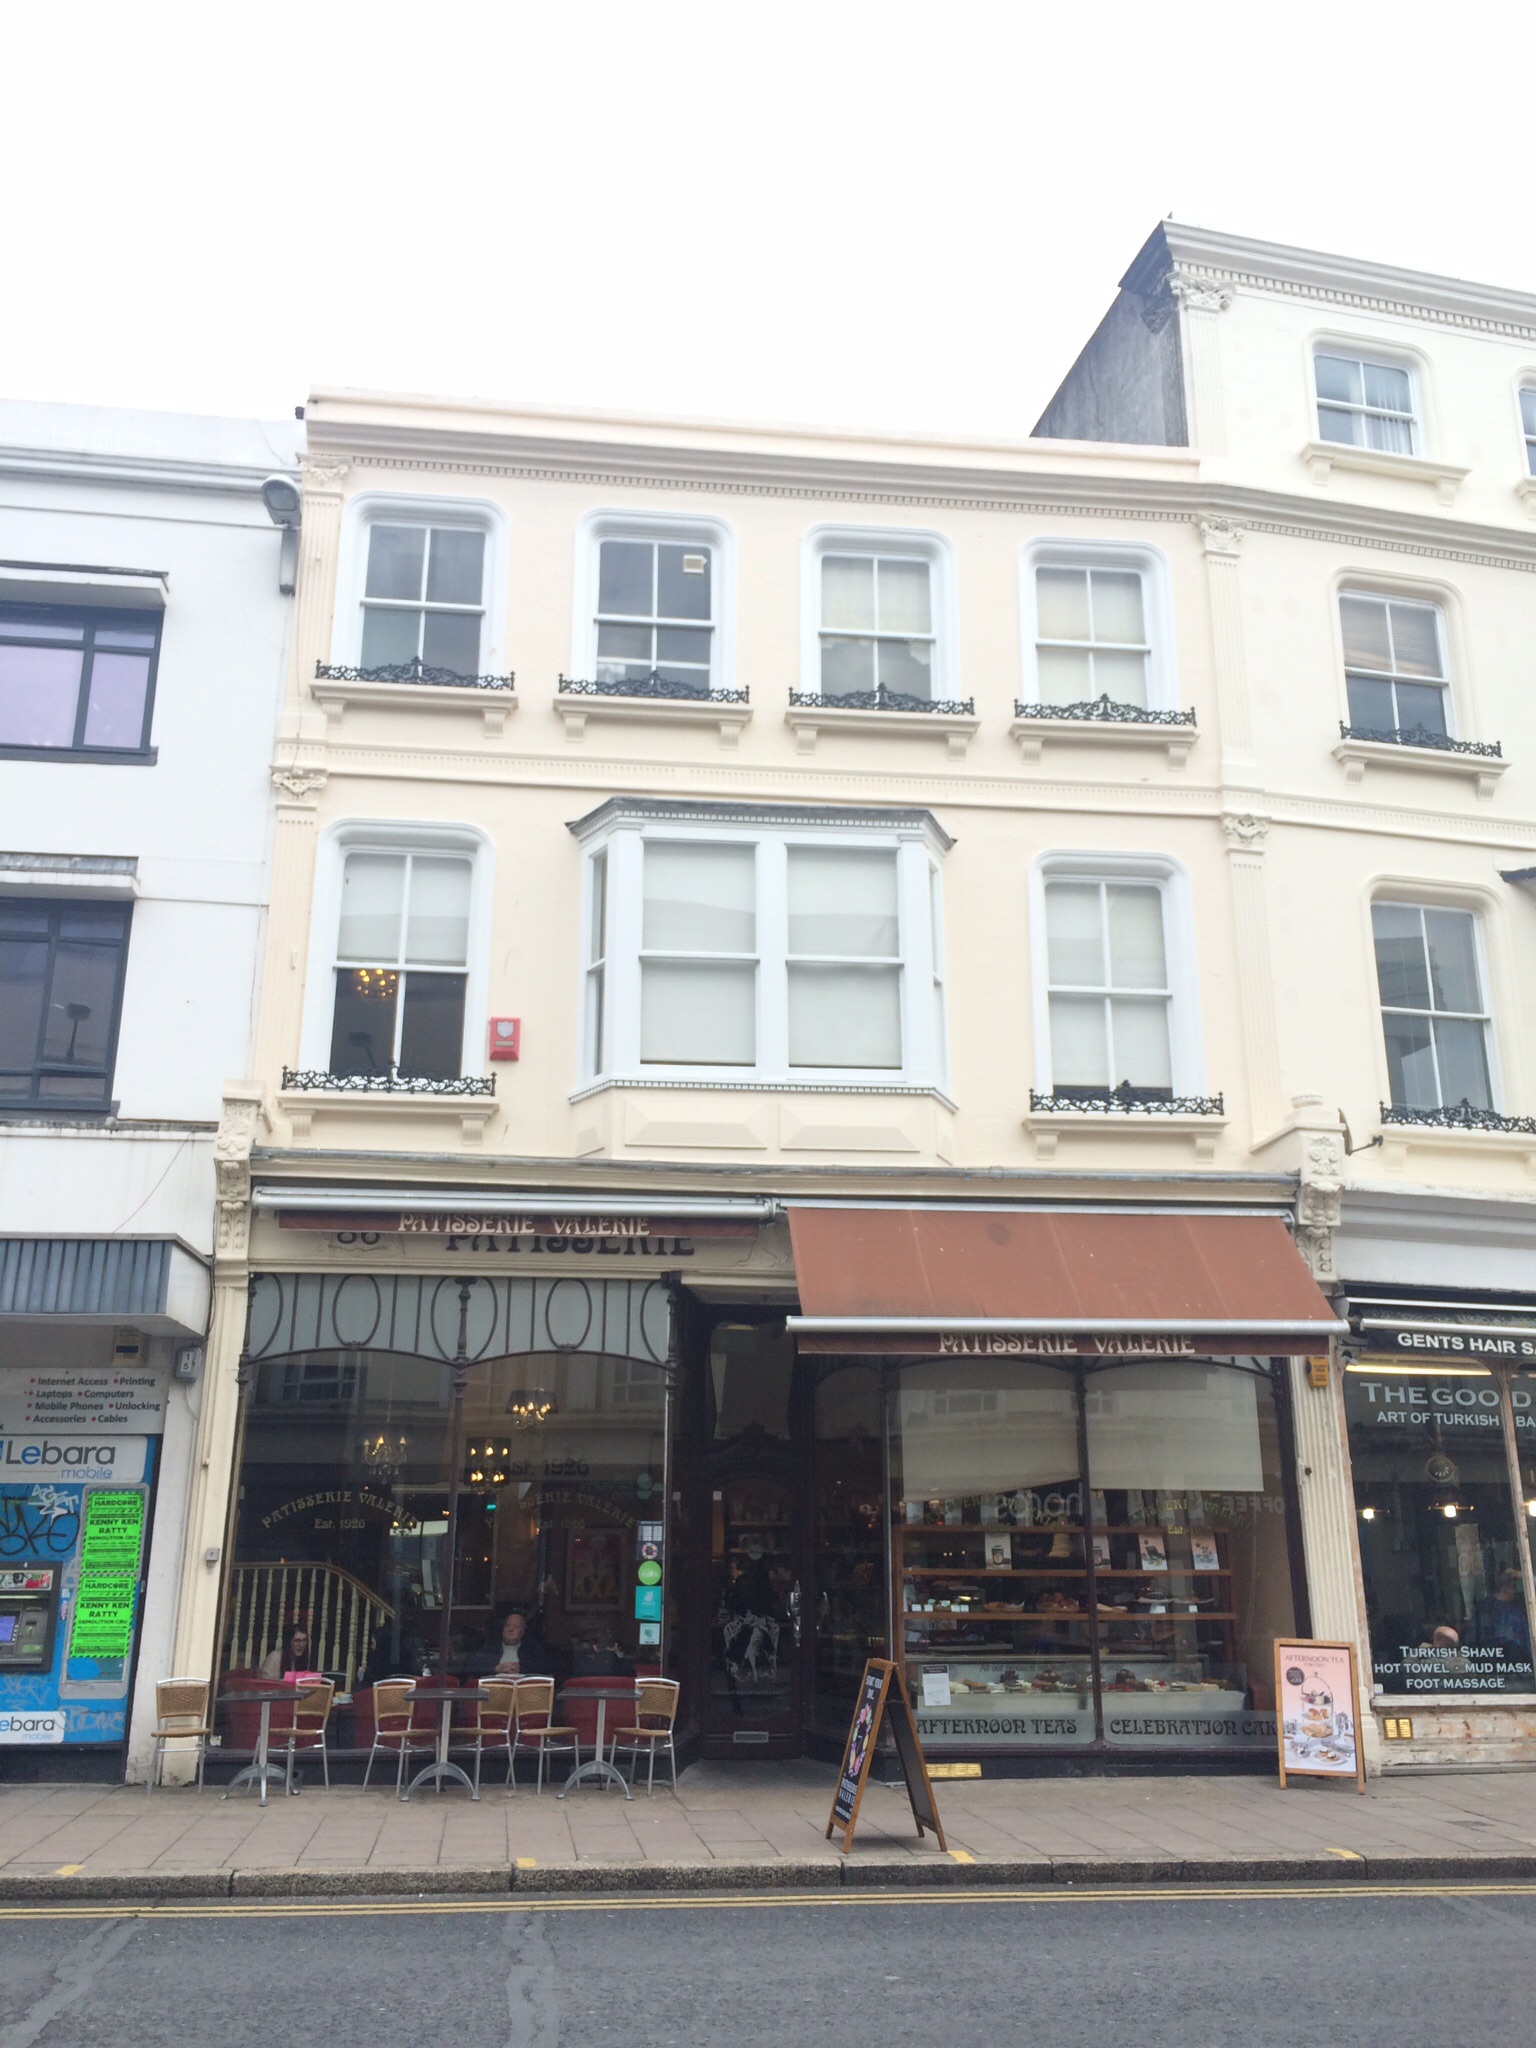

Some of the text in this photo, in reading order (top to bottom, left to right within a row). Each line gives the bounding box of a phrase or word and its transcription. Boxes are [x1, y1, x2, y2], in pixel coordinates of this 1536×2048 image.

[398, 1213, 650, 1236] PATISSERIE VALERIE
[938, 1332, 1195, 1354] PATISSERIE VALERIE
[1397, 1333, 1465, 1350] GENTS
[1469, 1337, 1518, 1354] HAIR
[37, 1376, 156, 1387] Internet Access Printing
[36, 1389, 135, 1399] Laptops Computers
[1359, 1382, 1429, 1404] THE
[35, 1402, 161, 1412] Mobile Phones Unlocking
[33, 1415, 128, 1423] Accessories Cables
[1377, 1411, 1407, 1423] ART
[1410, 1411, 1431, 1424] OF
[1433, 1413, 1500, 1427] TURKISH
[6, 1441, 116, 1465] Lebara
[61, 1467, 113, 1479] mobile
[261, 1491, 353, 1530] PATISSERIE
[89, 1518, 119, 1526] KENNY
[314, 1518, 366, 1529] Est. 1926
[85, 1582, 130, 1590] HARDCORE
[1285, 1654, 1345, 1664] AFTERNOON TEA
[1374, 1663, 1401, 1674] HOT
[1403, 1663, 1450, 1673] TOWEL
[1465, 1663, 1494, 1673] MUD
[1496, 1662, 1533, 1673] MASK
[1406, 1677, 1506, 1689] FOOT MASSAGE
[916, 1718, 1078, 1735] AFTERNOON TEAS
[1109, 1718, 1238, 1737] CELEBRATION
[22, 1732, 54, 1740] mobile
